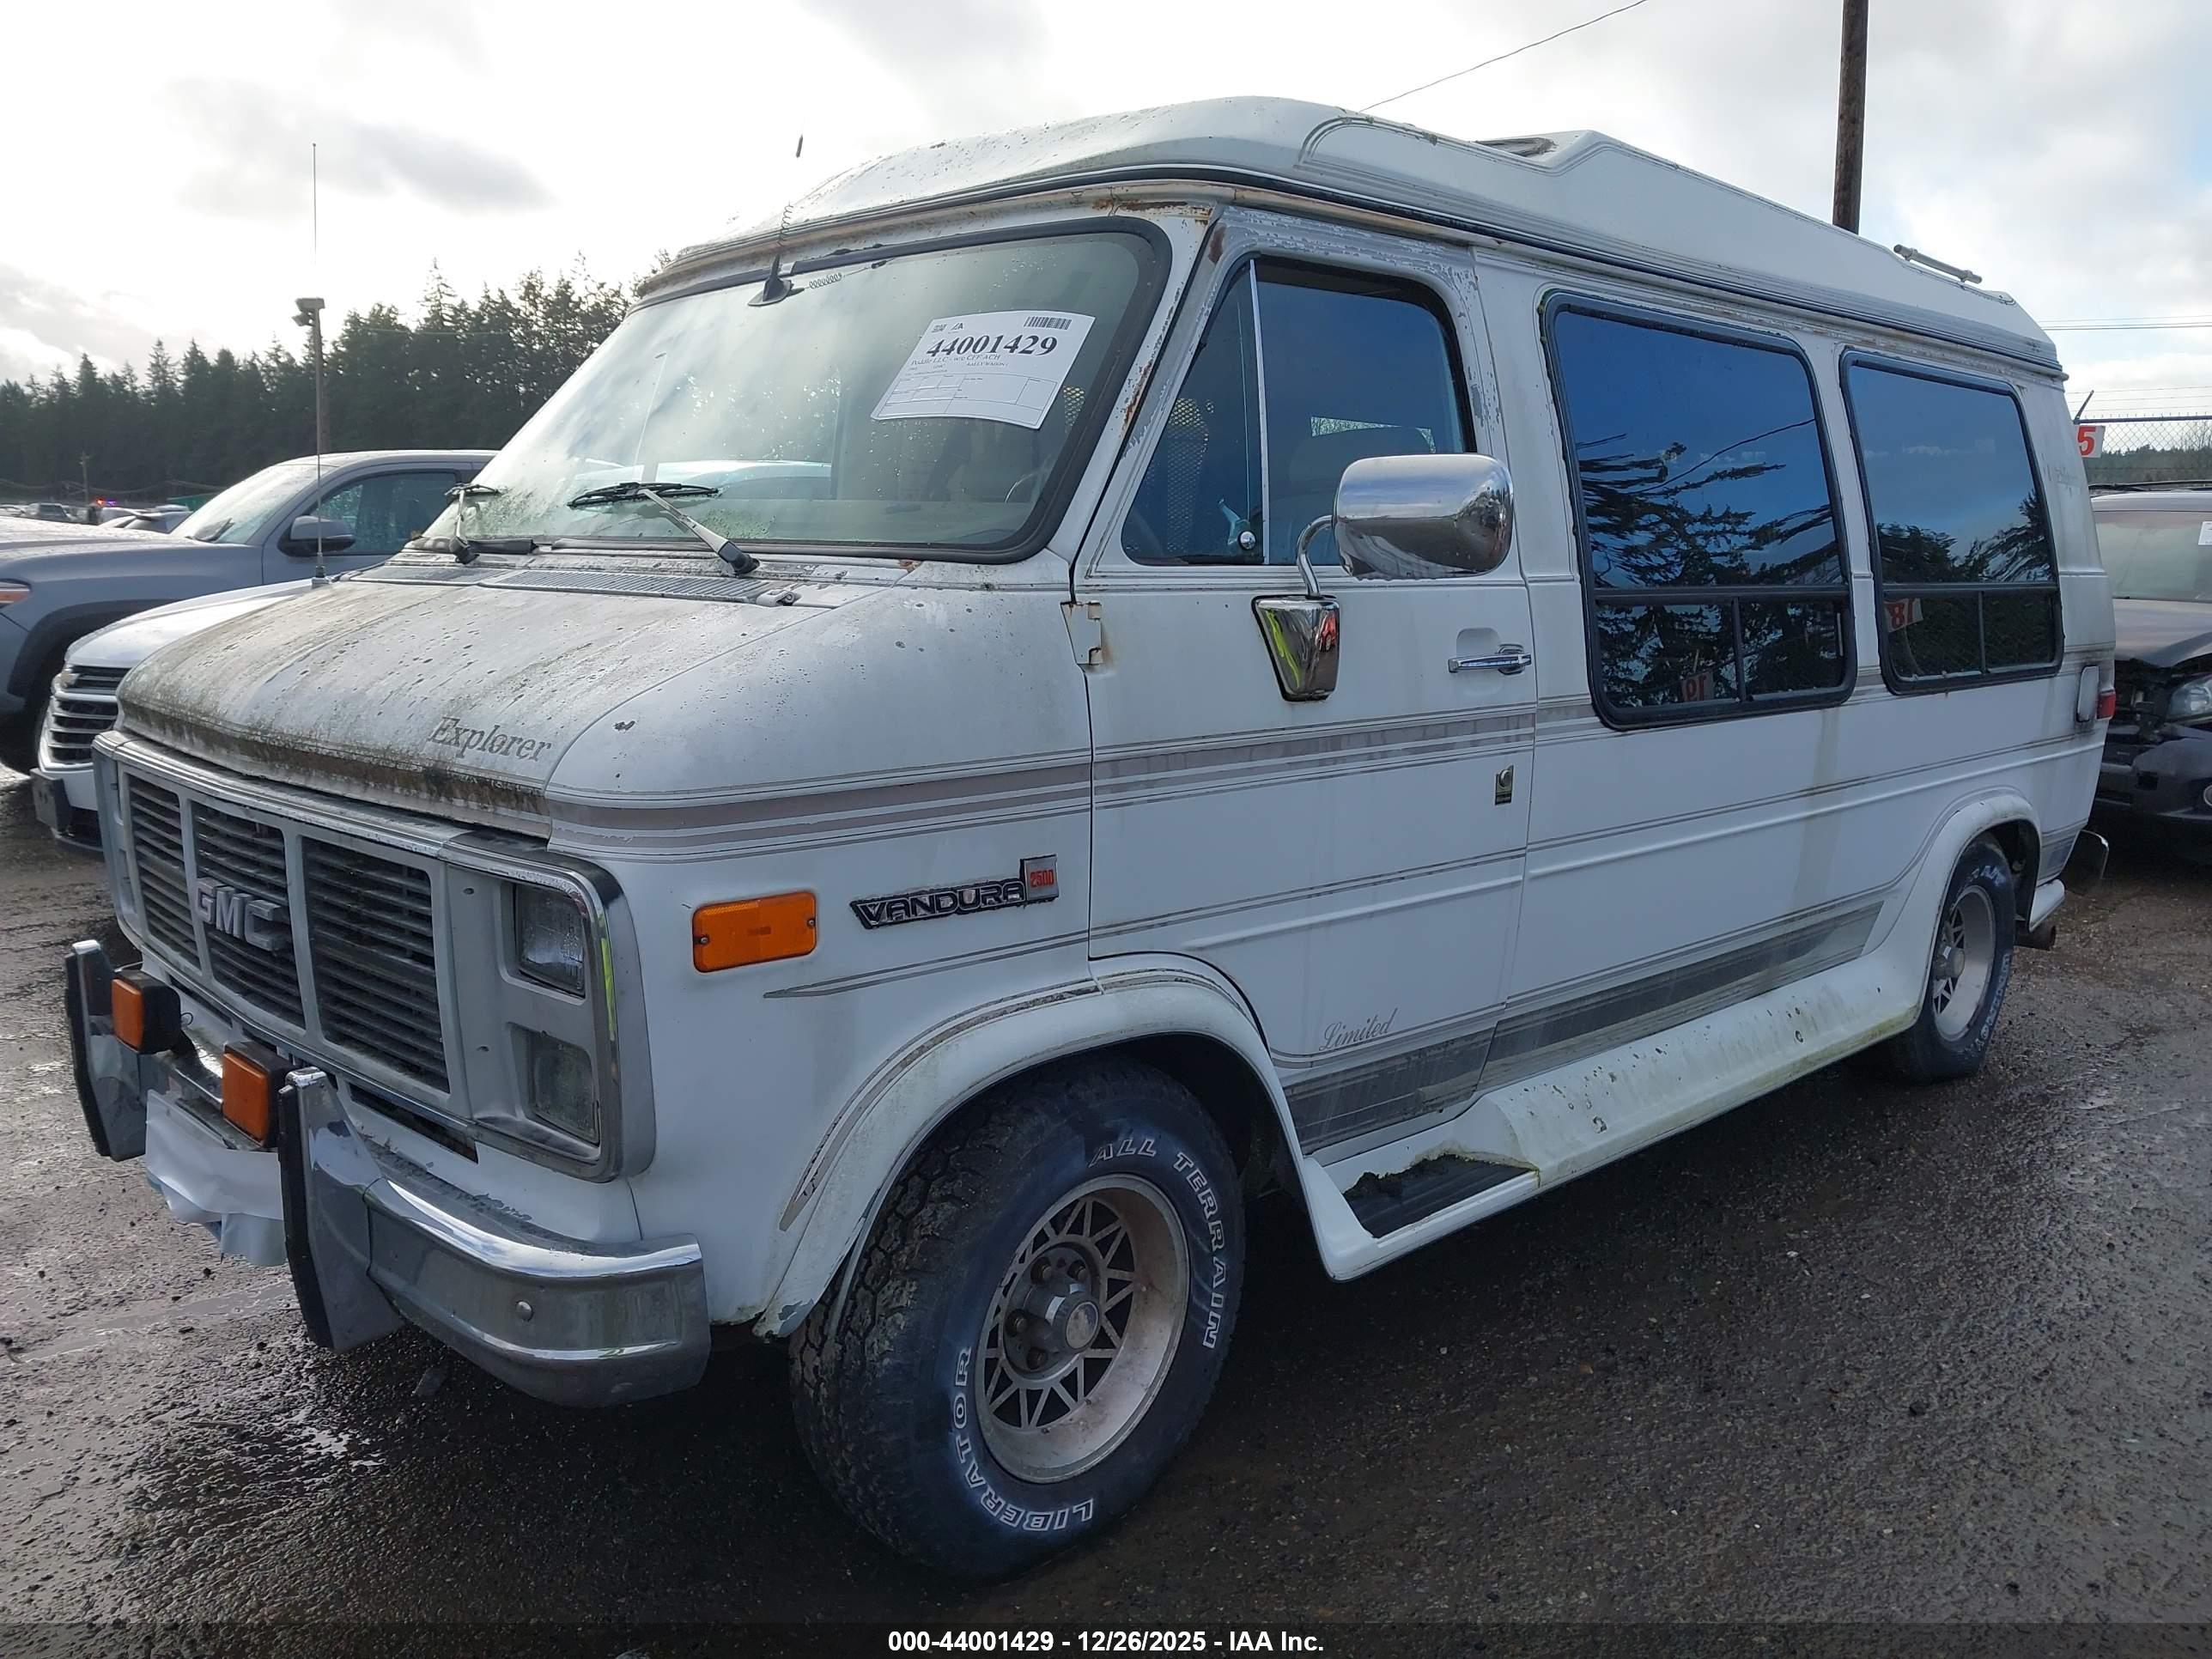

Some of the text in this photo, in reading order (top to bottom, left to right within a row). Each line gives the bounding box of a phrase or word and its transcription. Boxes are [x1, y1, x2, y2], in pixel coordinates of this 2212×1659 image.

[927, 334, 1058, 357] 44001429
[2077, 426, 2097, 456] 5
[427, 716, 552, 763] Explorer
[195, 877, 281, 952] GMC
[857, 881, 1026, 927] VANDURA
[1318, 1007, 1398, 1051] Limited
[1088, 1137, 1226, 1349] ALL TERRAIN
[954, 1346, 1095, 1532] LIBERATOR
